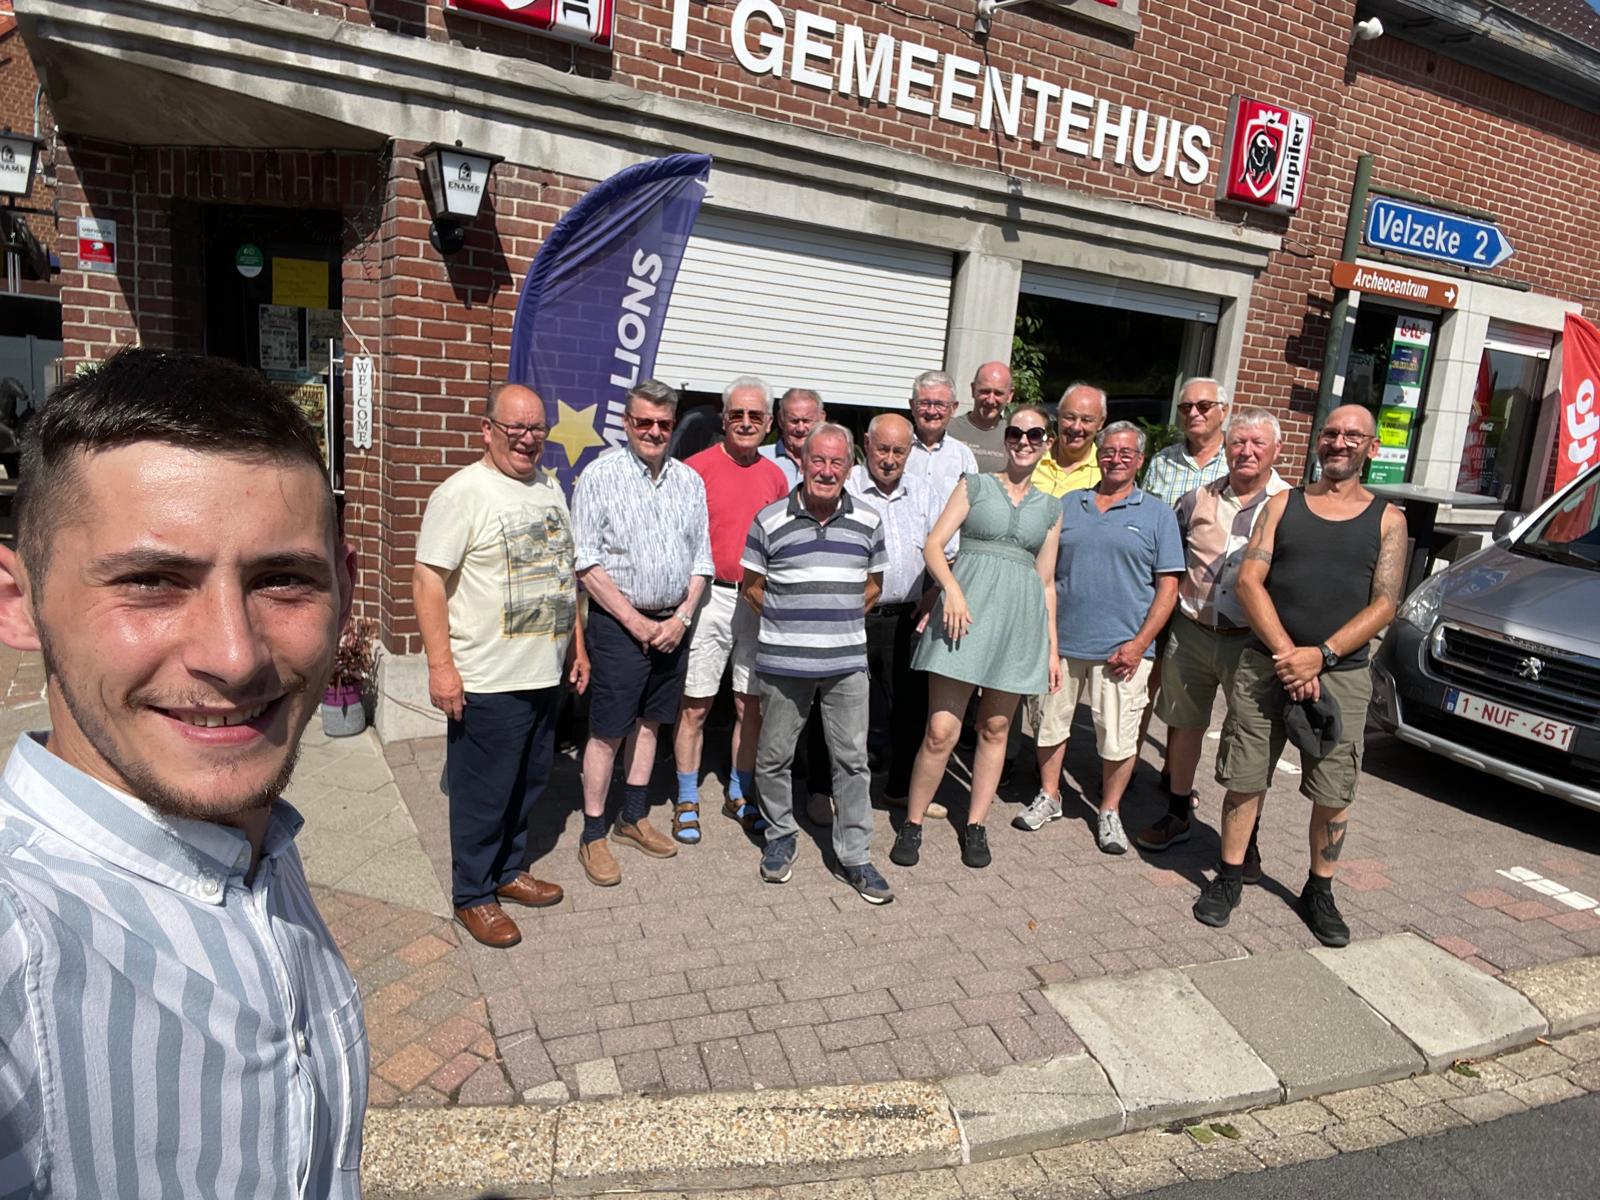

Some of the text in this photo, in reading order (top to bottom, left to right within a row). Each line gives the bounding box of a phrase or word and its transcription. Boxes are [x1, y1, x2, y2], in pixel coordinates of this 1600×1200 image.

[730, 0, 1211, 185] GEMEENTEHUIS
[447, 180, 481, 193] ENAME
[1281, 119, 1304, 205] Jupiler
[1379, 207, 1489, 260] Velzeke 2
[1353, 268, 1429, 299] Archeocentrum
[356, 362, 369, 443] WELCOME
